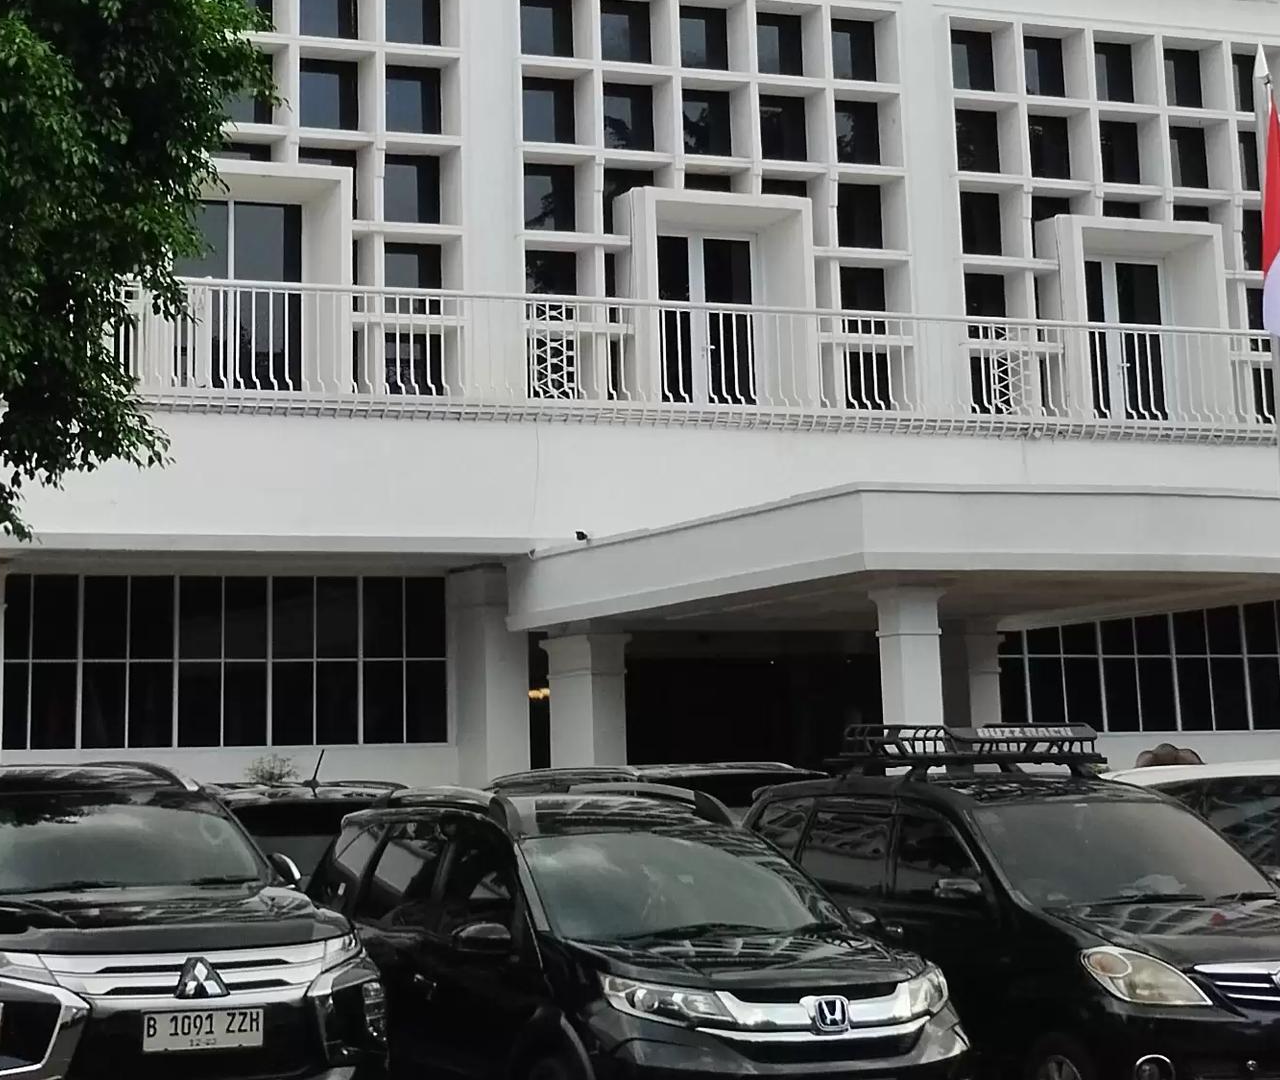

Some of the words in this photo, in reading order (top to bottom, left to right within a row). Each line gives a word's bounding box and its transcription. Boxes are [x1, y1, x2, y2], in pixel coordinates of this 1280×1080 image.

[146, 1016, 157, 1038] B
[169, 1013, 215, 1036] 1091
[225, 1011, 260, 1034] ZZH
